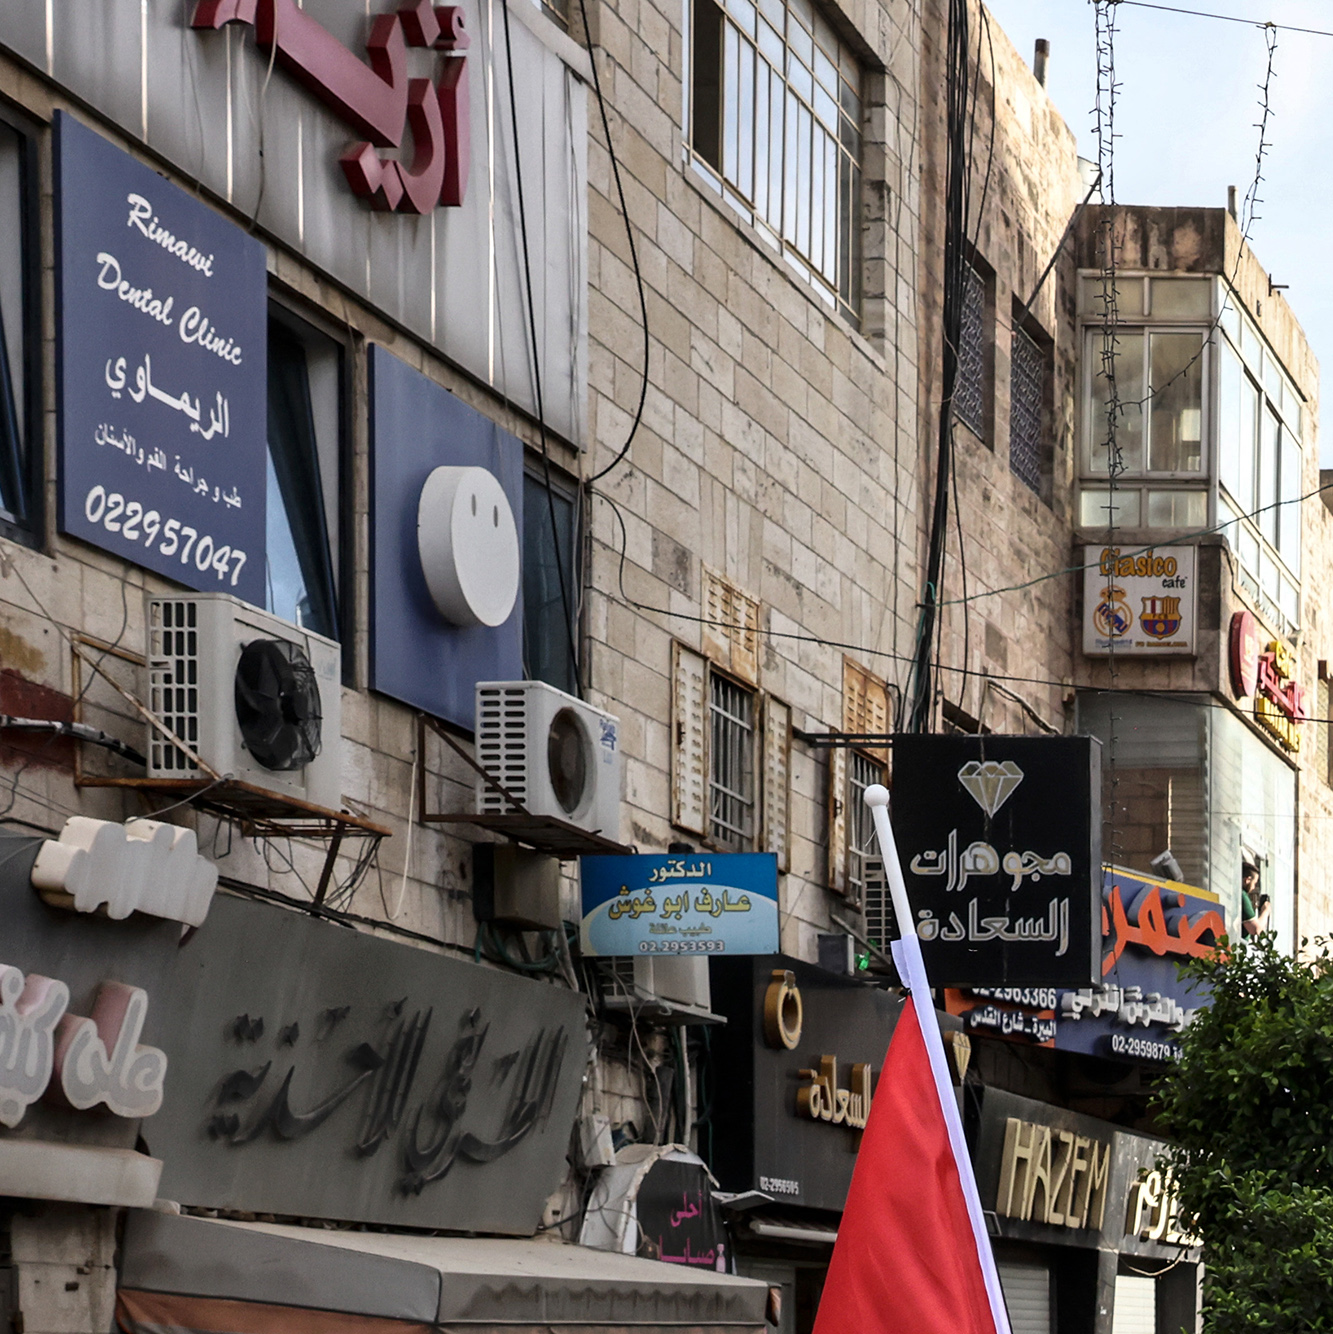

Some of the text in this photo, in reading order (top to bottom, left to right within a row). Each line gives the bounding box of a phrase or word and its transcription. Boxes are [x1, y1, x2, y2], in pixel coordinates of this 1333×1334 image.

[126, 193, 215, 277] Rimawi
[96, 252, 243, 366] Dental Clinic
[104, 353, 230, 440] الريماوي
[85, 485, 248, 587] 022957047
[648, 860, 712, 882] الدكتور
[909, 828, 1072, 892] مجوهرات
[608, 885, 657, 919] غوش
[694, 887, 752, 917] عارف
[916, 897, 1070, 957] السعادة
[639, 940, 726, 952] 02.2953593
[798, 1055, 873, 1130] لسعادة
[998, 1117, 1111, 1231] HAZEM
[669, 1189, 703, 1228] أحلى
